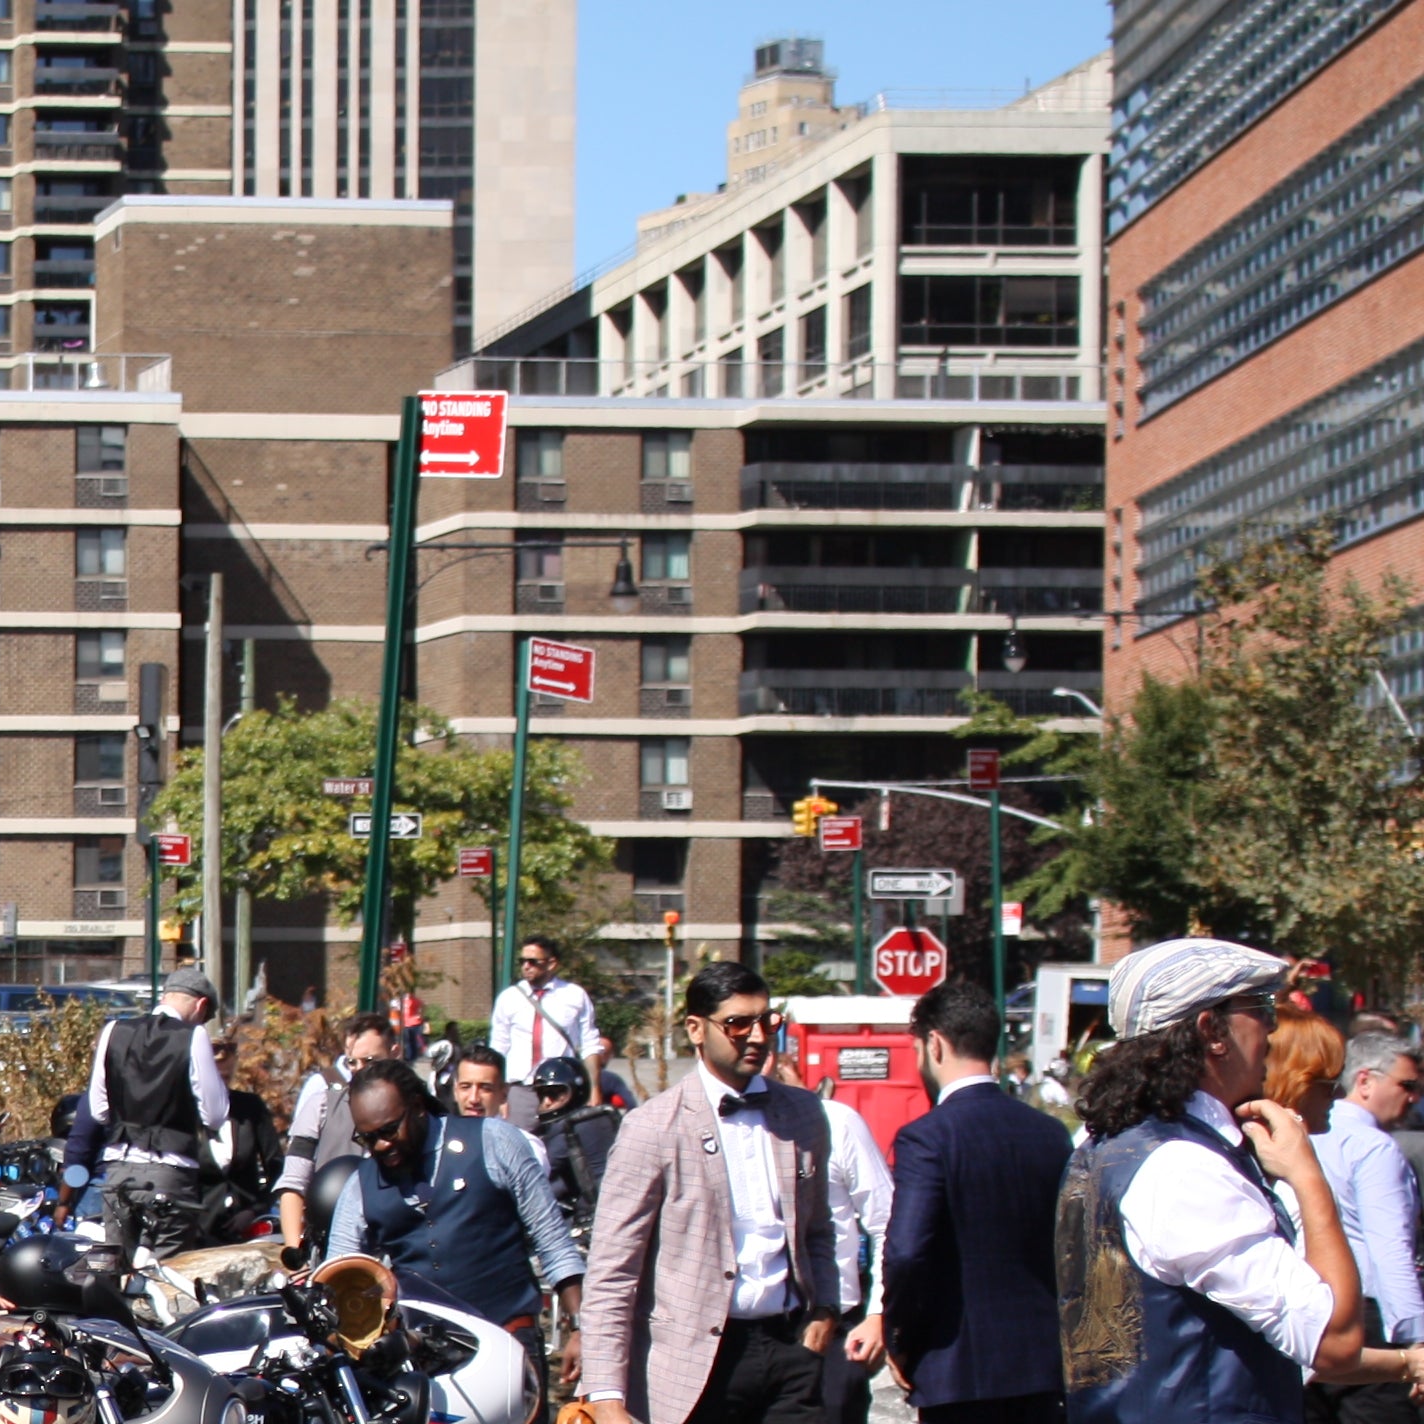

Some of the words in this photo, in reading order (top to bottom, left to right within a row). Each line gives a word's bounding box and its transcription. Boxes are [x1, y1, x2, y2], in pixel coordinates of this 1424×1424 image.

[439, 401, 492, 417] STANDING
[423, 419, 465, 439] Anytime
[546, 646, 583, 664] STANDING
[324, 781, 355, 794] Water
[878, 879, 903, 890] ONE
[878, 950, 942, 977] STOP
